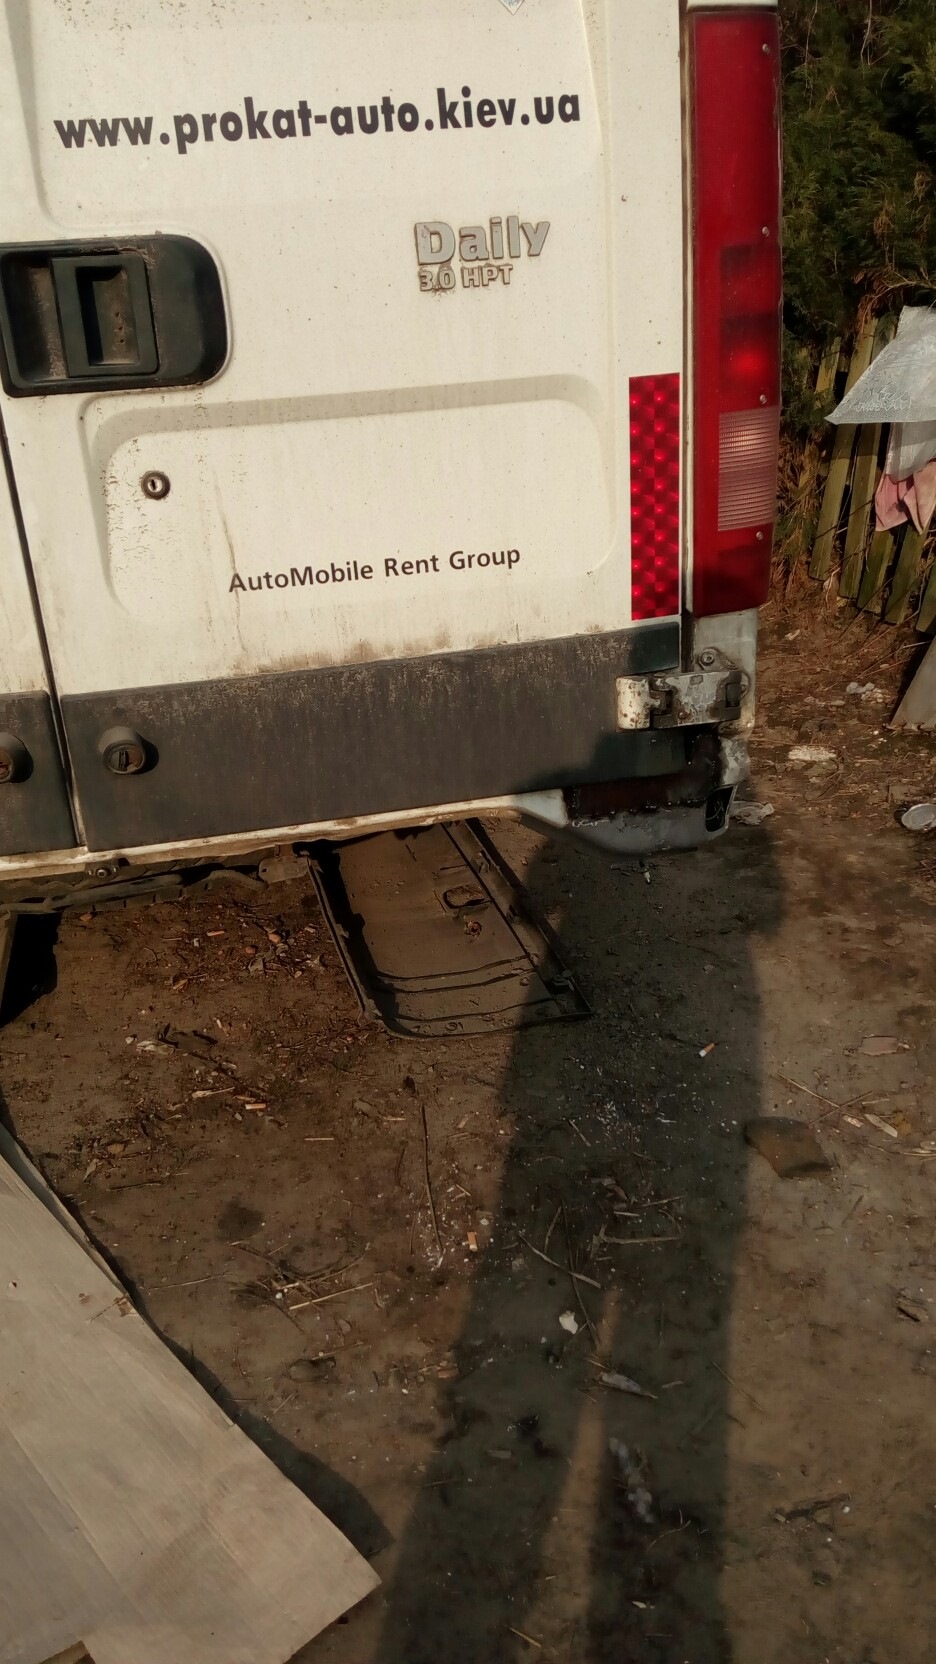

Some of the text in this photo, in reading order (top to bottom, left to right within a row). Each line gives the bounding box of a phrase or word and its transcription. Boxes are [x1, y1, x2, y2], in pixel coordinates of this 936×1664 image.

[54, 86, 580, 154] www.prokat-auto.kiev.ua
[414, 215, 550, 265] Daily
[461, 264, 513, 288] HPT
[229, 549, 520, 592] AutoMobile Rent Group
